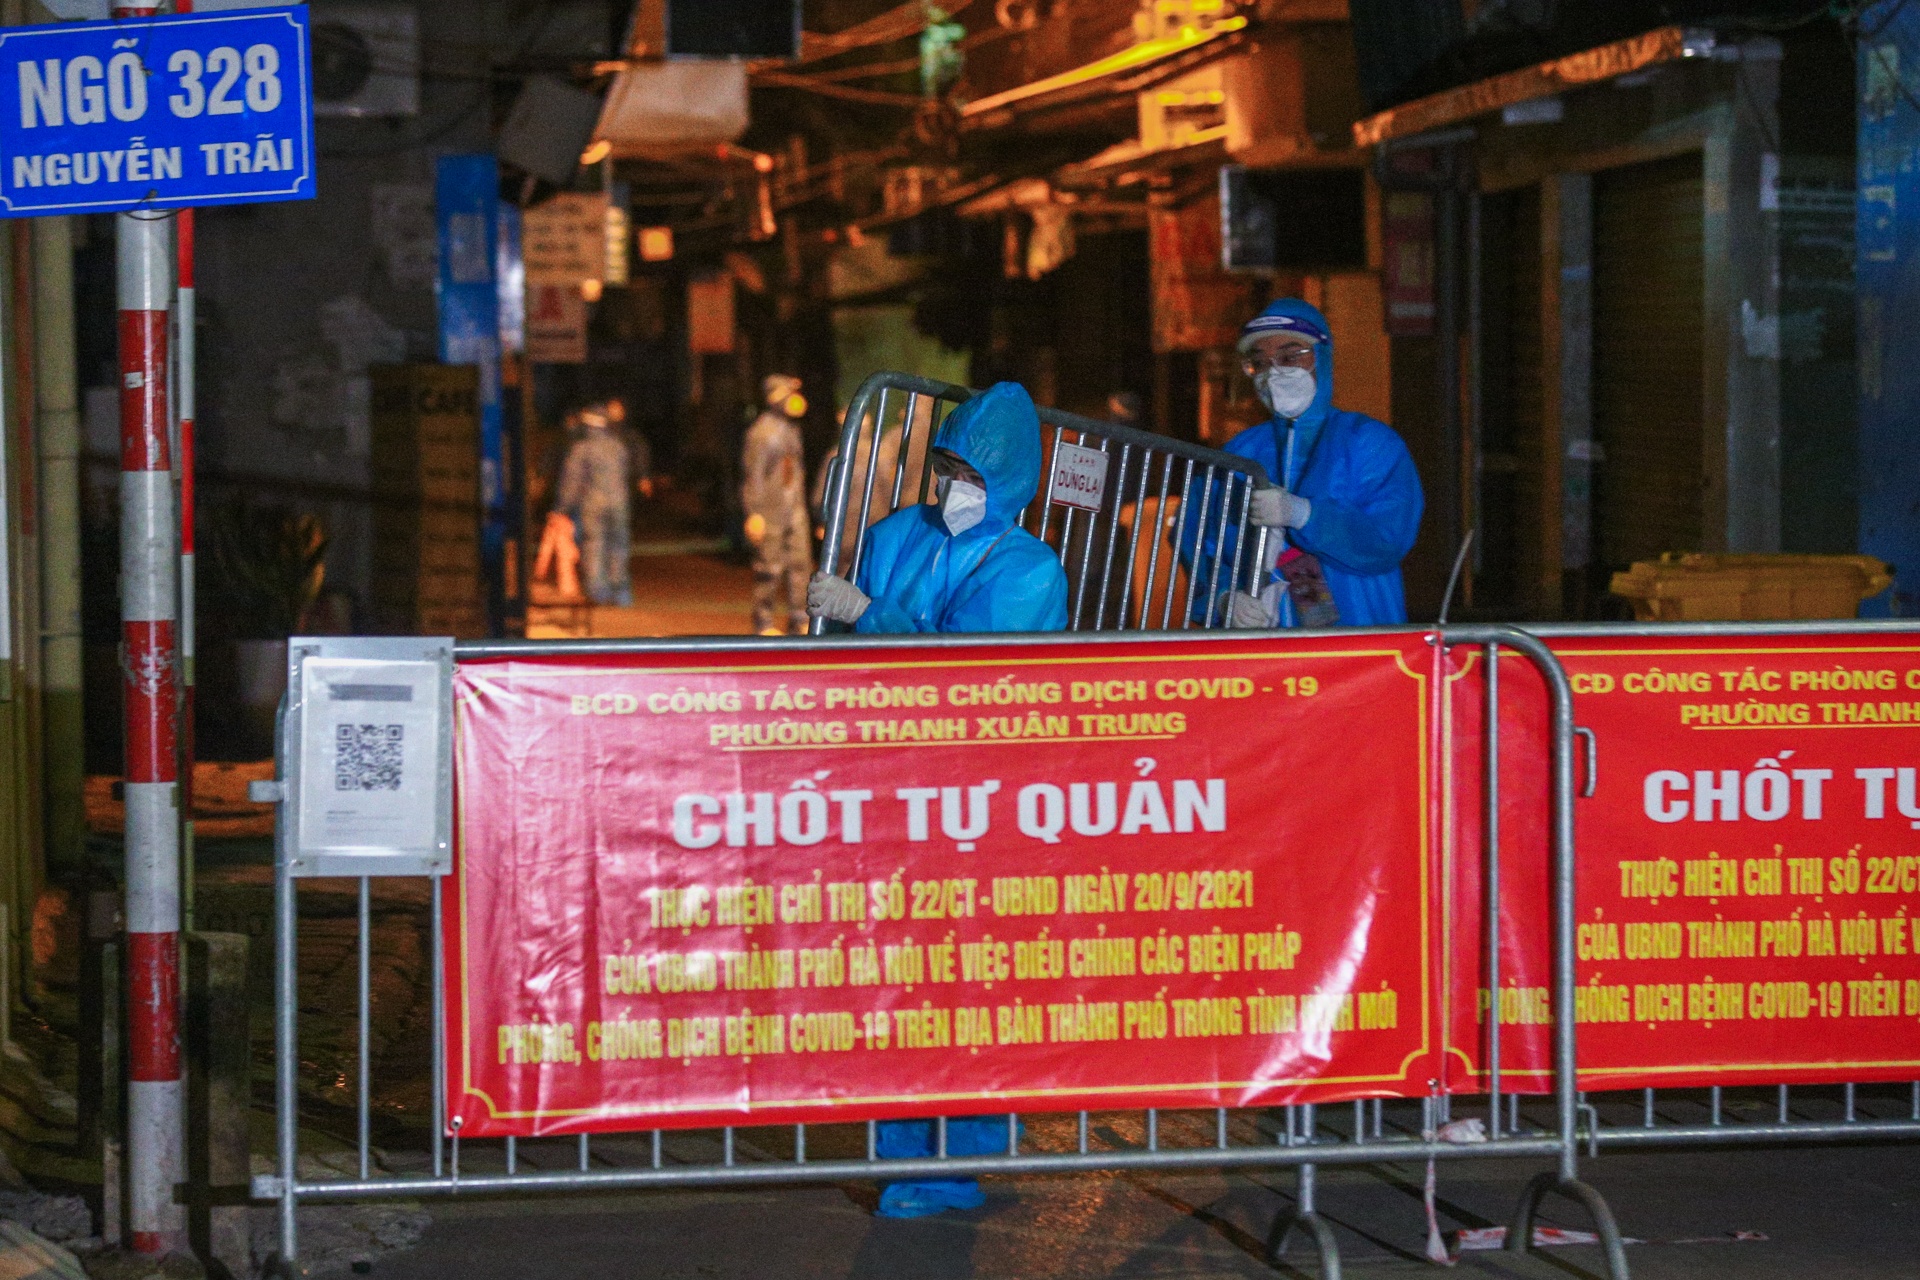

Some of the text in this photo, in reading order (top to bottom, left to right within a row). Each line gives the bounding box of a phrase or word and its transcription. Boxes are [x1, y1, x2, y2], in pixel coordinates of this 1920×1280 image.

[18, 38, 283, 129] NGÕ 328
[13, 133, 295, 189] NGUYỄN TRÃI
[648, 687, 742, 714] CÔNG
[750, 684, 816, 710] TÁC
[825, 681, 938, 708] PHÒNG
[948, 674, 1062, 706] CHỐNG
[1071, 677, 1147, 708] DỊCH
[1155, 677, 1253, 700] COVID
[1282, 676, 1318, 697] 19
[1623, 667, 1712, 692] CÔNG
[1719, 666, 1781, 691] TÁC
[1790, 665, 1897, 690] PHÒNG
[710, 711, 1187, 746] PHƯỜNG THANH XUÂN TRUNG
[1681, 698, 1920, 725] PHƯỜNG THANH
[672, 757, 1227, 852] CHỐT TỰ QUẢN
[1643, 750, 1833, 824] CHỐT
[650, 886, 711, 935] THỰC
[717, 878, 775, 933] HIỆN
[780, 869, 822, 925] CHỈ
[828, 883, 867, 929] THỊ
[871, 867, 905, 919] SỐ
[1064, 866, 1129, 913] NGÀY
[1134, 870, 1254, 910] 20/9/2021
[1619, 857, 1680, 905] THỰC
[1684, 851, 1739, 905] HIỆN
[1743, 844, 1782, 896] CHỈ
[1787, 857, 1823, 903] THỊ
[1829, 843, 1862, 895] SỐ
[606, 938, 651, 995] CỦA
[655, 950, 718, 993] UBND
[721, 943, 794, 990] THÀNH
[801, 933, 844, 987] PHỐ
[849, 939, 881, 985] HÀ
[885, 936, 924, 992] NỘI
[929, 930, 957, 983] VỀ
[961, 934, 1009, 989] VIỆC
[1069, 923, 1136, 977] CHỈNH
[1140, 927, 1185, 974] CÁC
[1189, 926, 1240, 981] BIỆN
[1244, 924, 1301, 971] PHÁP
[1577, 907, 1620, 961] CỦA
[1625, 921, 1682, 960] UBND
[1687, 913, 1755, 959] THÀNH
[1760, 907, 1803, 957] PHỐ
[1807, 911, 1836, 955] HÀ
[1840, 911, 1877, 964] NỘI
[1881, 905, 1907, 955] VỀ
[586, 1006, 662, 1060] CHỐNG
[667, 1016, 720, 1066] DỊCH
[725, 1008, 785, 1063] BỆNH
[790, 1010, 890, 1053] COVID-19
[894, 1001, 950, 1049] TRÊN
[997, 997, 1043, 1045] BÀN
[1048, 994, 1119, 1042] THÀNH
[1124, 986, 1167, 1039] PHỐ
[1172, 997, 1243, 1037] TRONG
[1247, 988, 1297, 1035] TÌNH
[1575, 972, 1630, 1024] HỐNG
[1634, 984, 1684, 1029] DỊCH
[1688, 975, 1744, 1028] BỆNH
[1749, 981, 1843, 1019] COVID-19
[1847, 972, 1900, 1016] TRÊN
